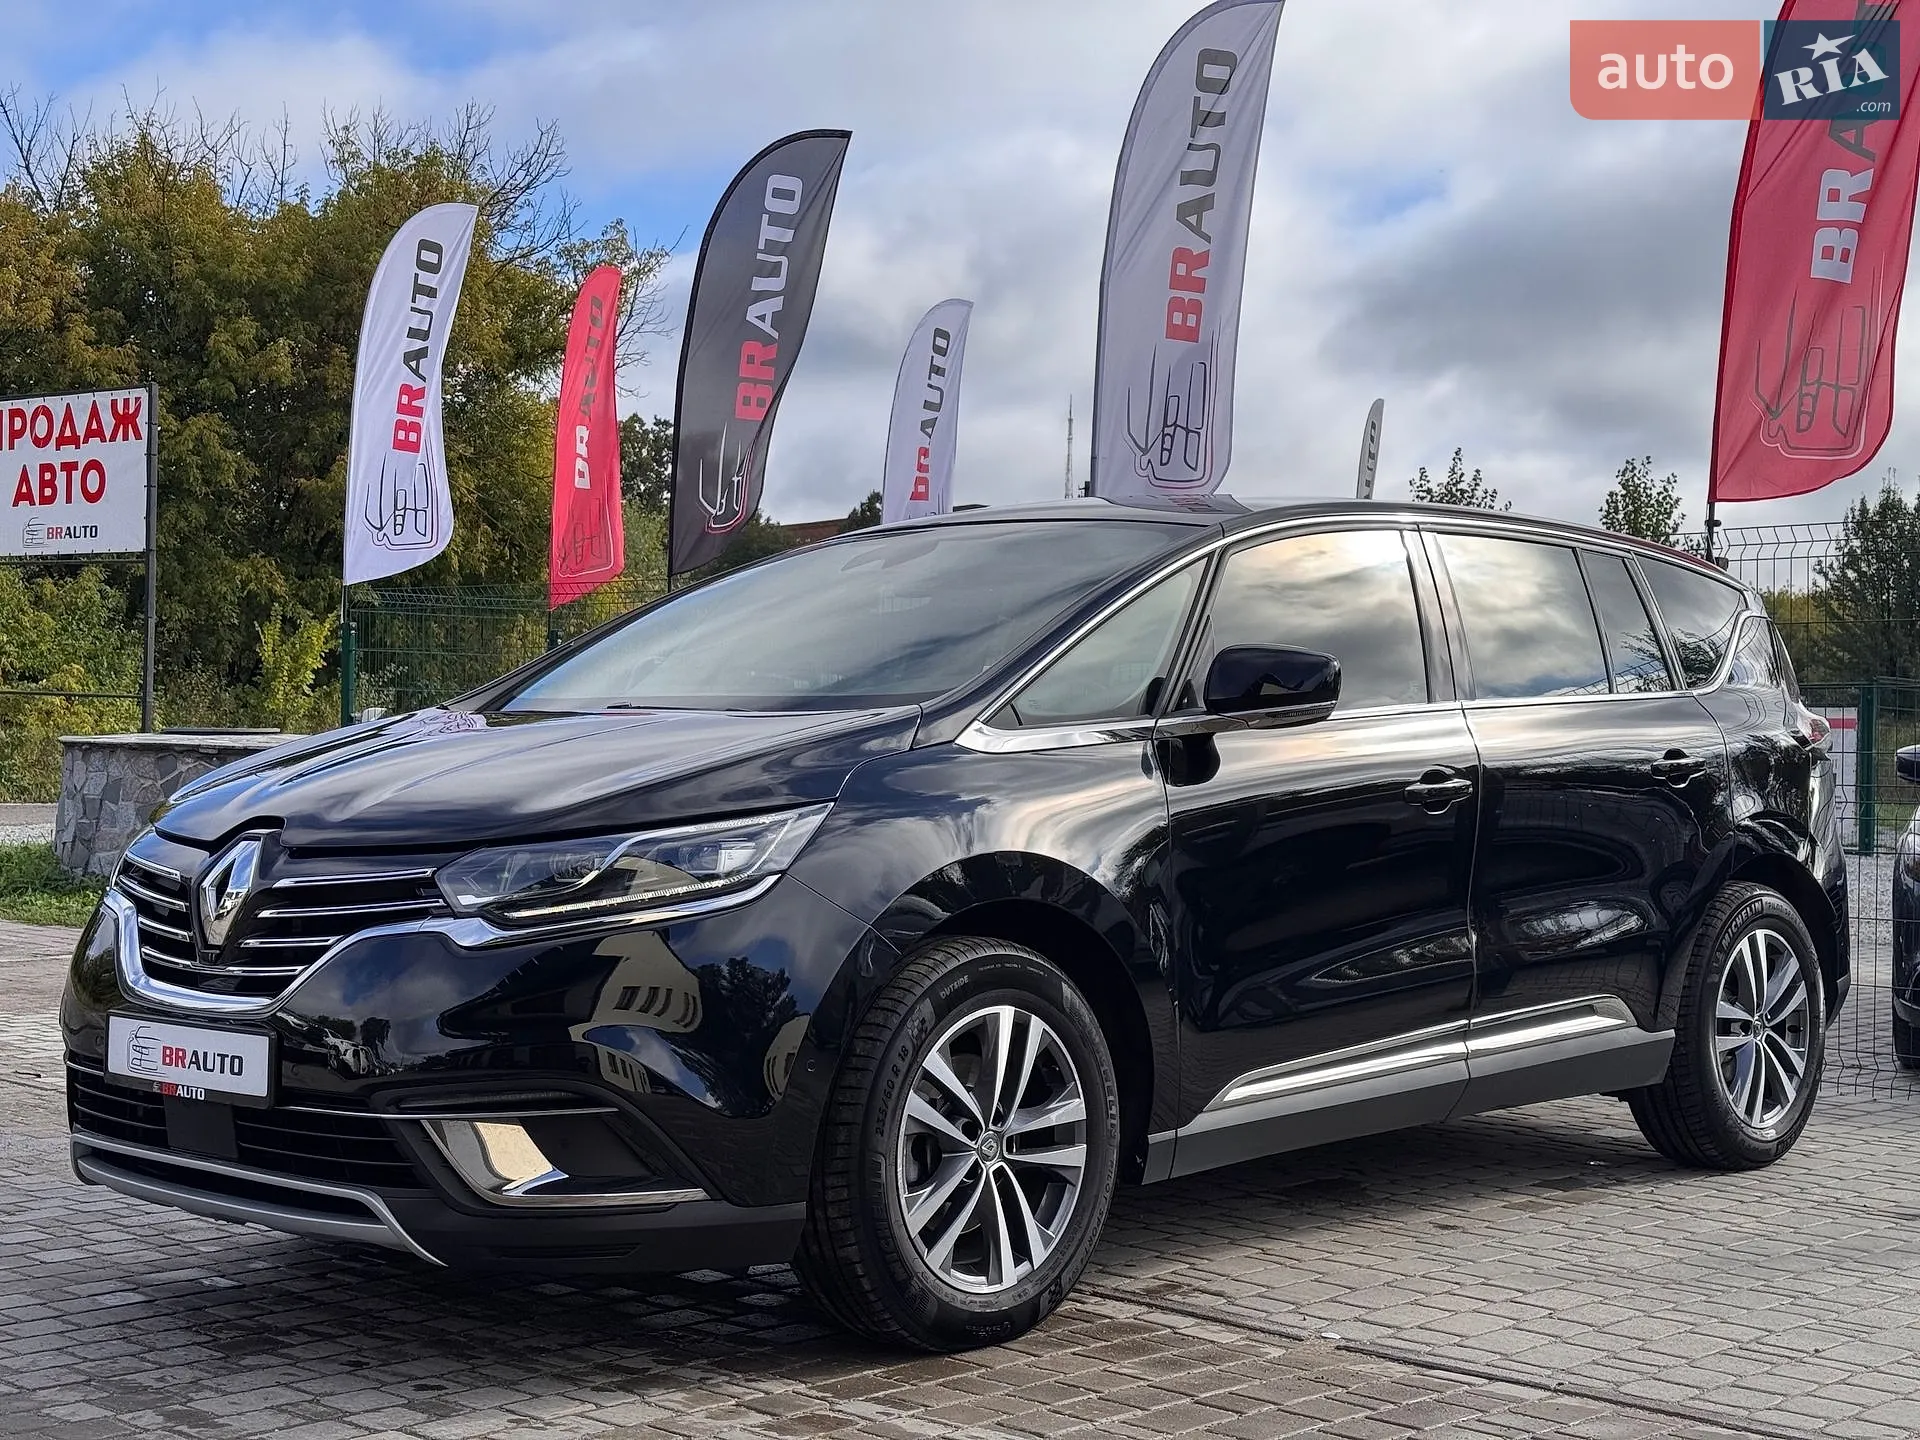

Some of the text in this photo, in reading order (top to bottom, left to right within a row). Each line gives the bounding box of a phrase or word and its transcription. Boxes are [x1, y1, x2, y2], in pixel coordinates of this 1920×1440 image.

[1166, 48, 1238, 343] BRAUTO
[735, 174, 803, 421] BRAUTO
[392, 238, 443, 454] BRAUTO
[12, 458, 107, 507] АВТО
[46, 524, 98, 541] BRAUTO
[1721, 901, 1762, 950] MICHELIN
[940, 974, 970, 999] OUTSIDE
[161, 1045, 243, 1077] BRAUTO
[160, 1082, 205, 1101] BRAUTO
